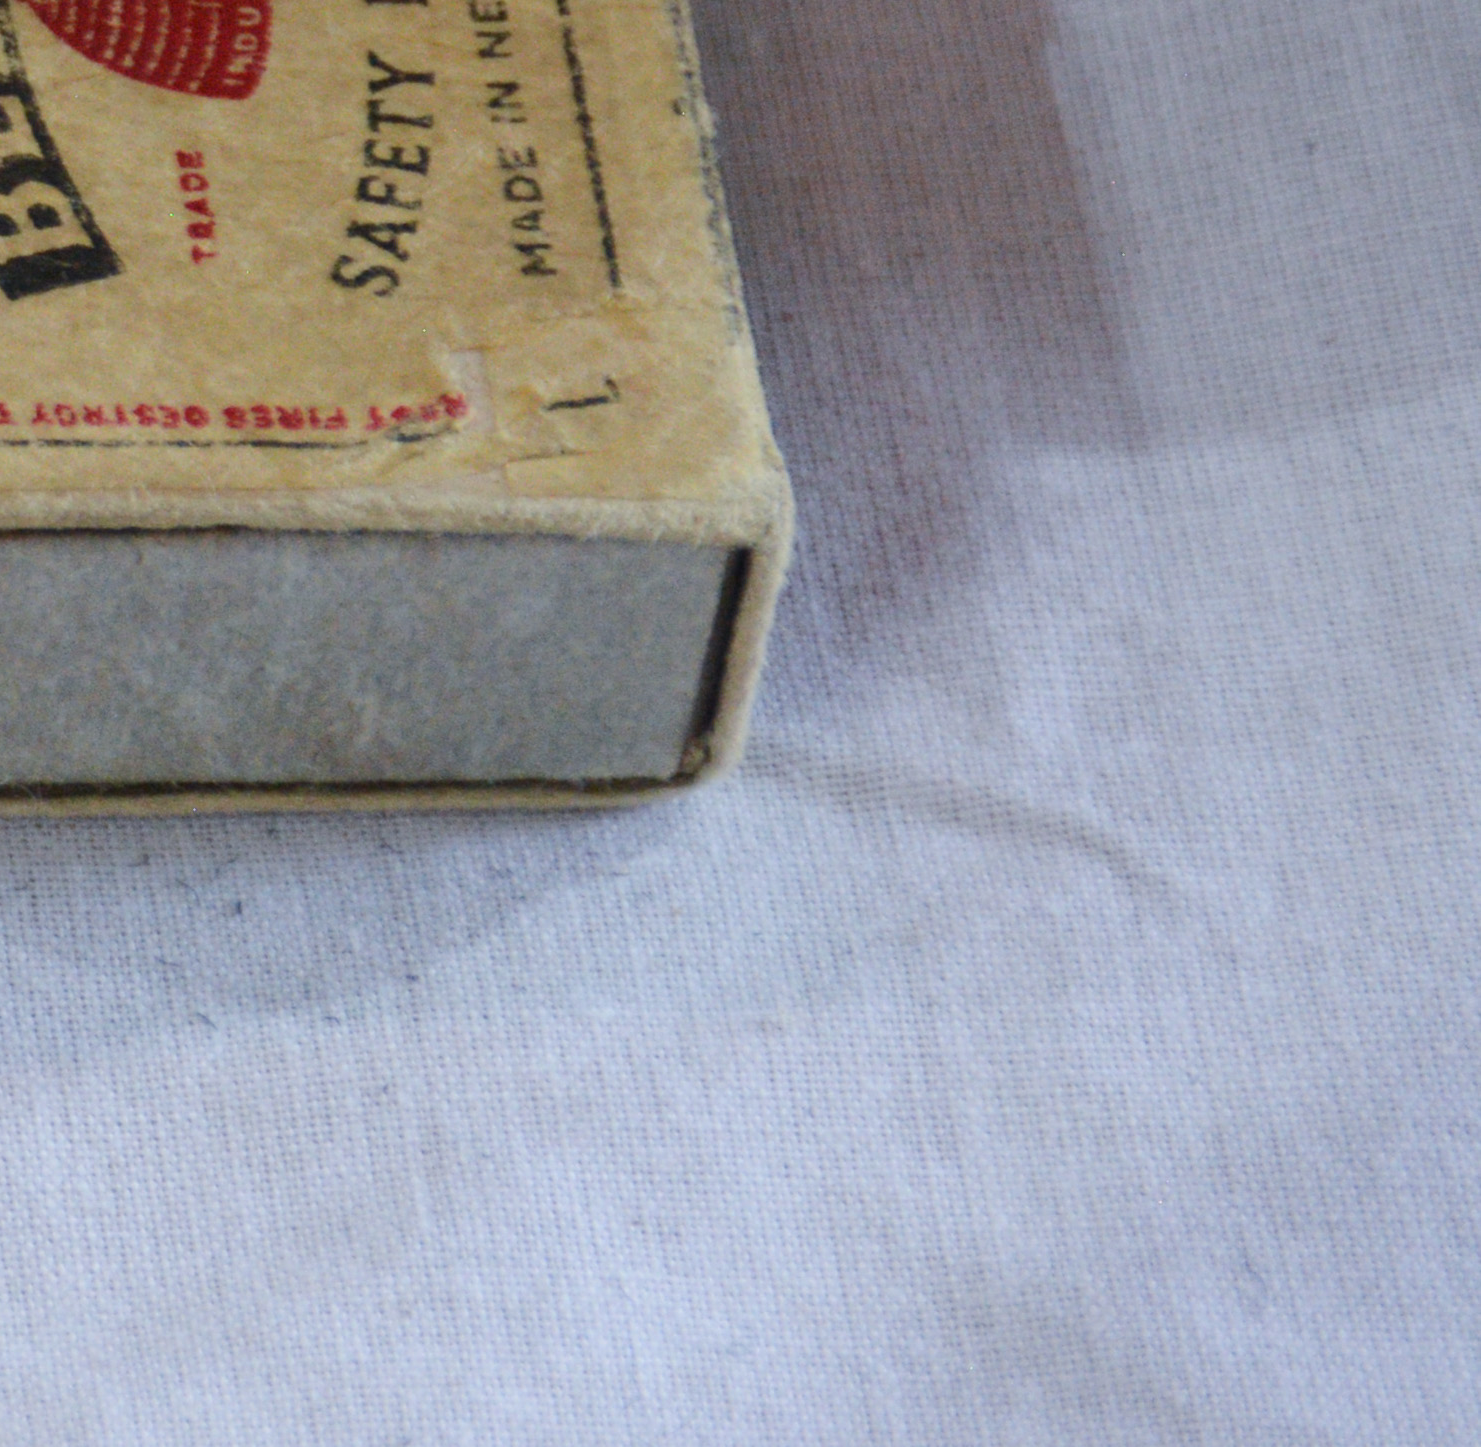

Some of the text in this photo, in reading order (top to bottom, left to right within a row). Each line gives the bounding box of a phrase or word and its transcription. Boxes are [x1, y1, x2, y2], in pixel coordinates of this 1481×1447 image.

[484, 80, 528, 125] IN
[175, 149, 218, 266] TRADE
[329, 49, 436, 298] SAFETY
[497, 146, 557, 278] MADE
[32, 400, 211, 430] DESTROY
[221, 402, 348, 431] FIRES
